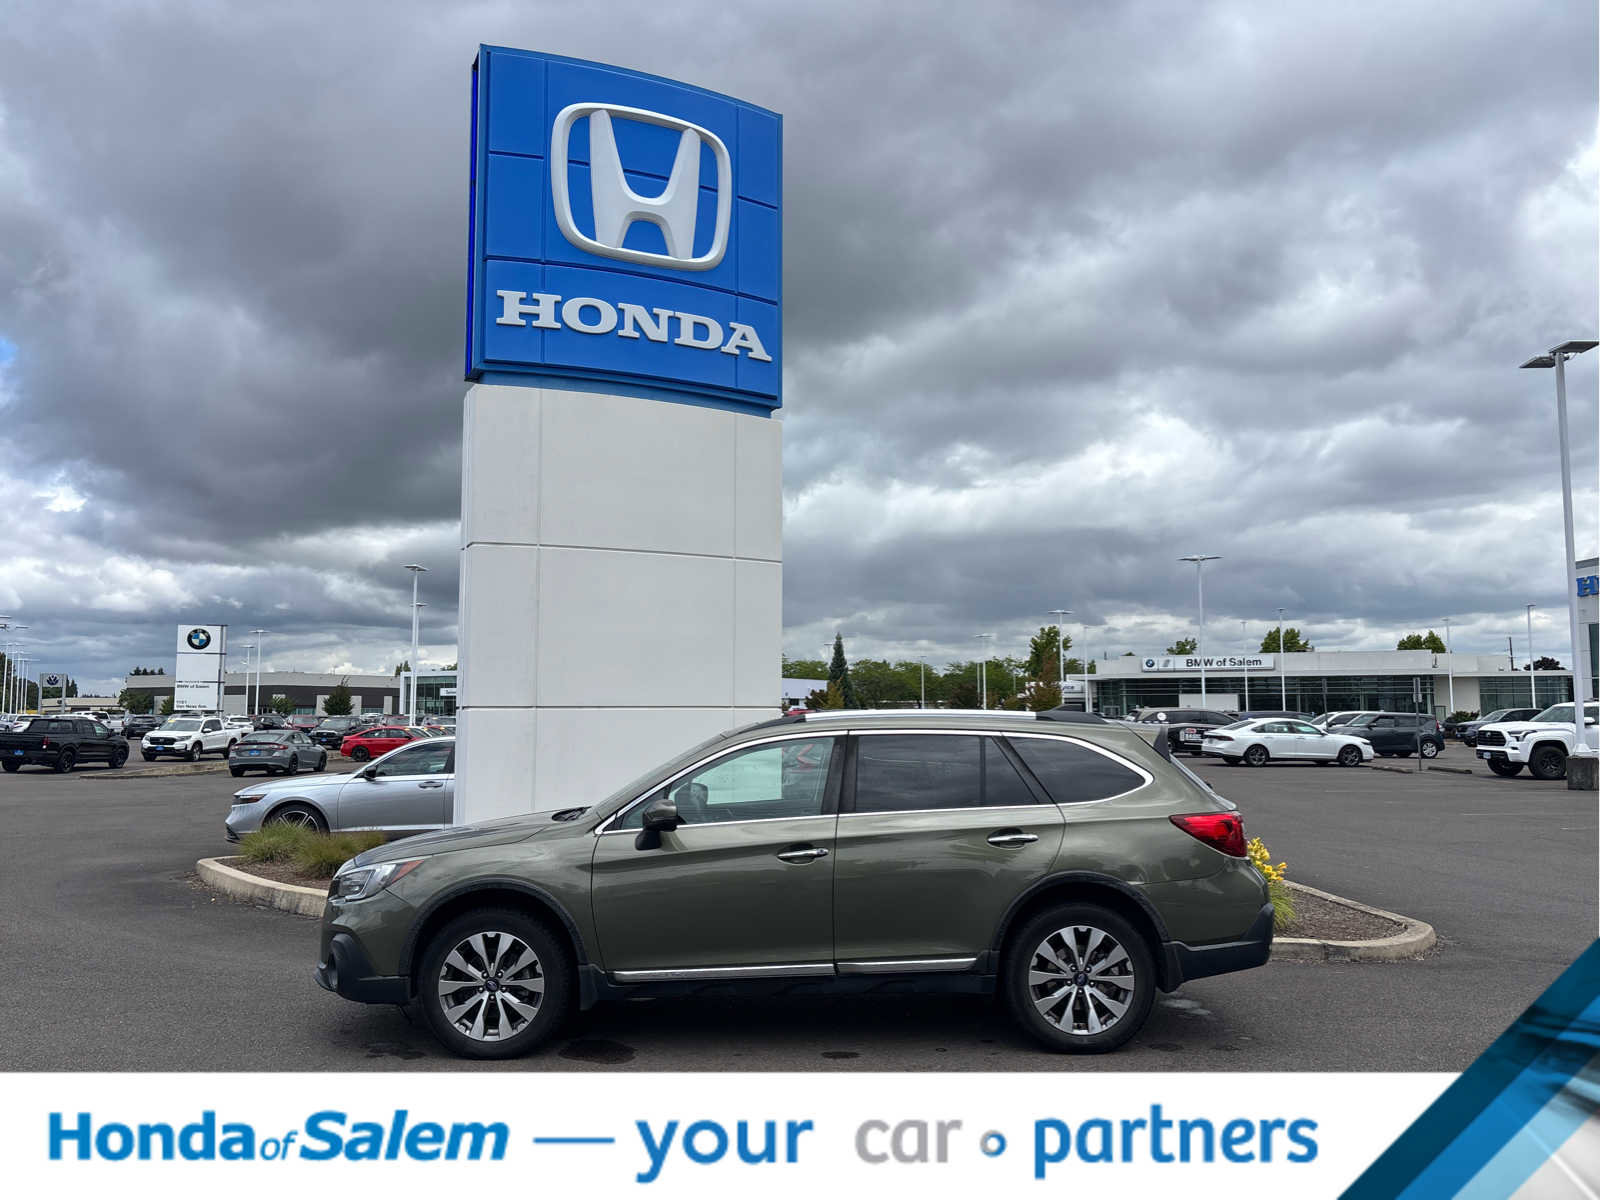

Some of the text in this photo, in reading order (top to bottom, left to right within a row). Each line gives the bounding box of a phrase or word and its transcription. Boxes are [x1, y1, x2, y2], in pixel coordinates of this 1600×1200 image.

[496, 289, 772, 361] HONDA
[1576, 575, 1599, 597] H
[1186, 657, 1262, 667] BMW of Salem
